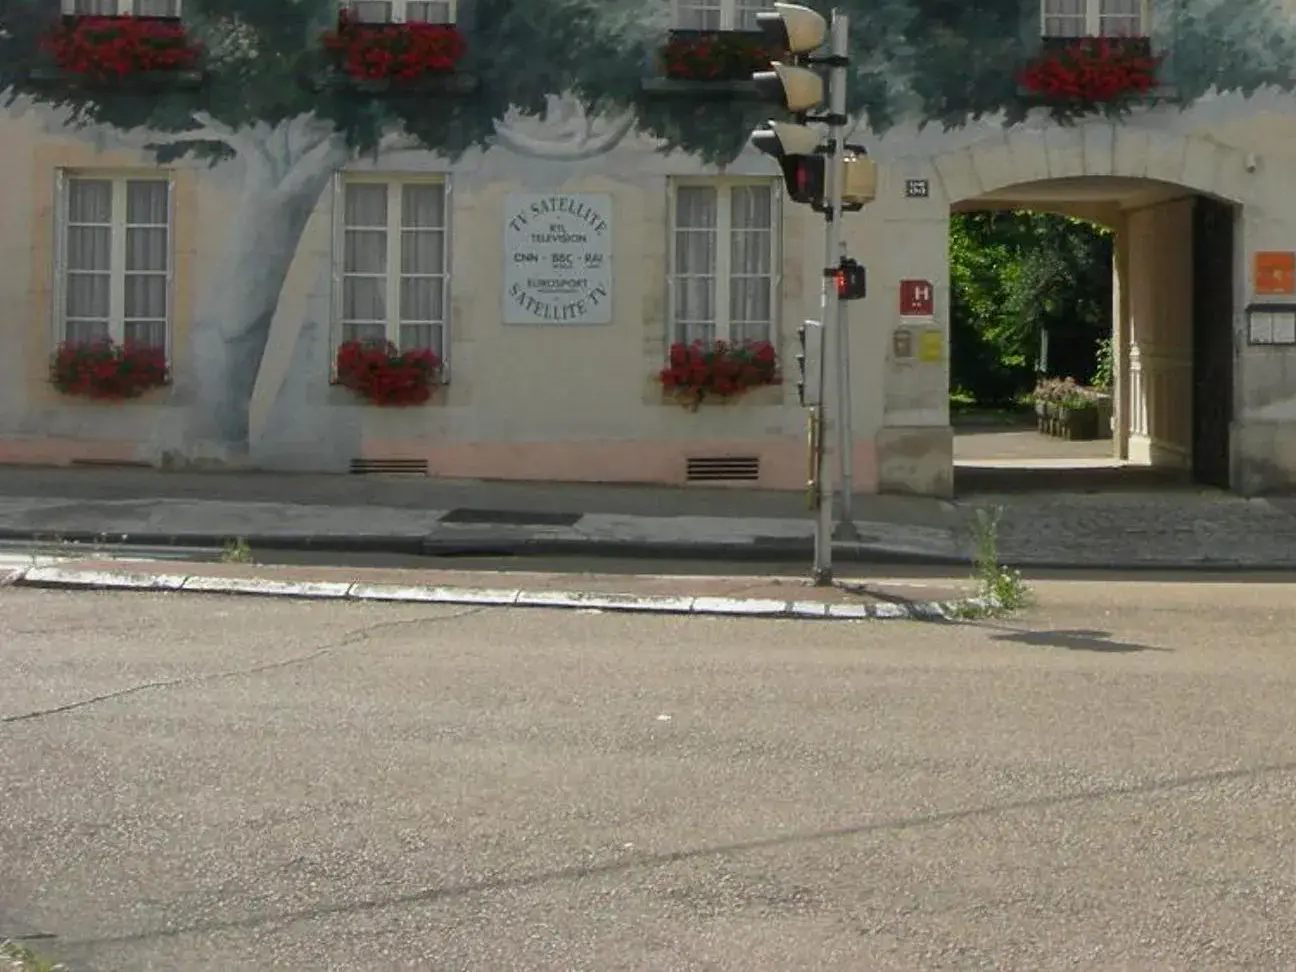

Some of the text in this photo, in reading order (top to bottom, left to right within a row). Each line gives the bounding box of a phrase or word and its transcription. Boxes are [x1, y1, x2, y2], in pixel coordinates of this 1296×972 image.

[509, 196, 607, 233] TV SATELLITE
[513, 253, 539, 263] CNN
[527, 278, 588, 288] EUROSPORT
[508, 282, 607, 320] SATELLITE TV
[914, 285, 929, 301] H
